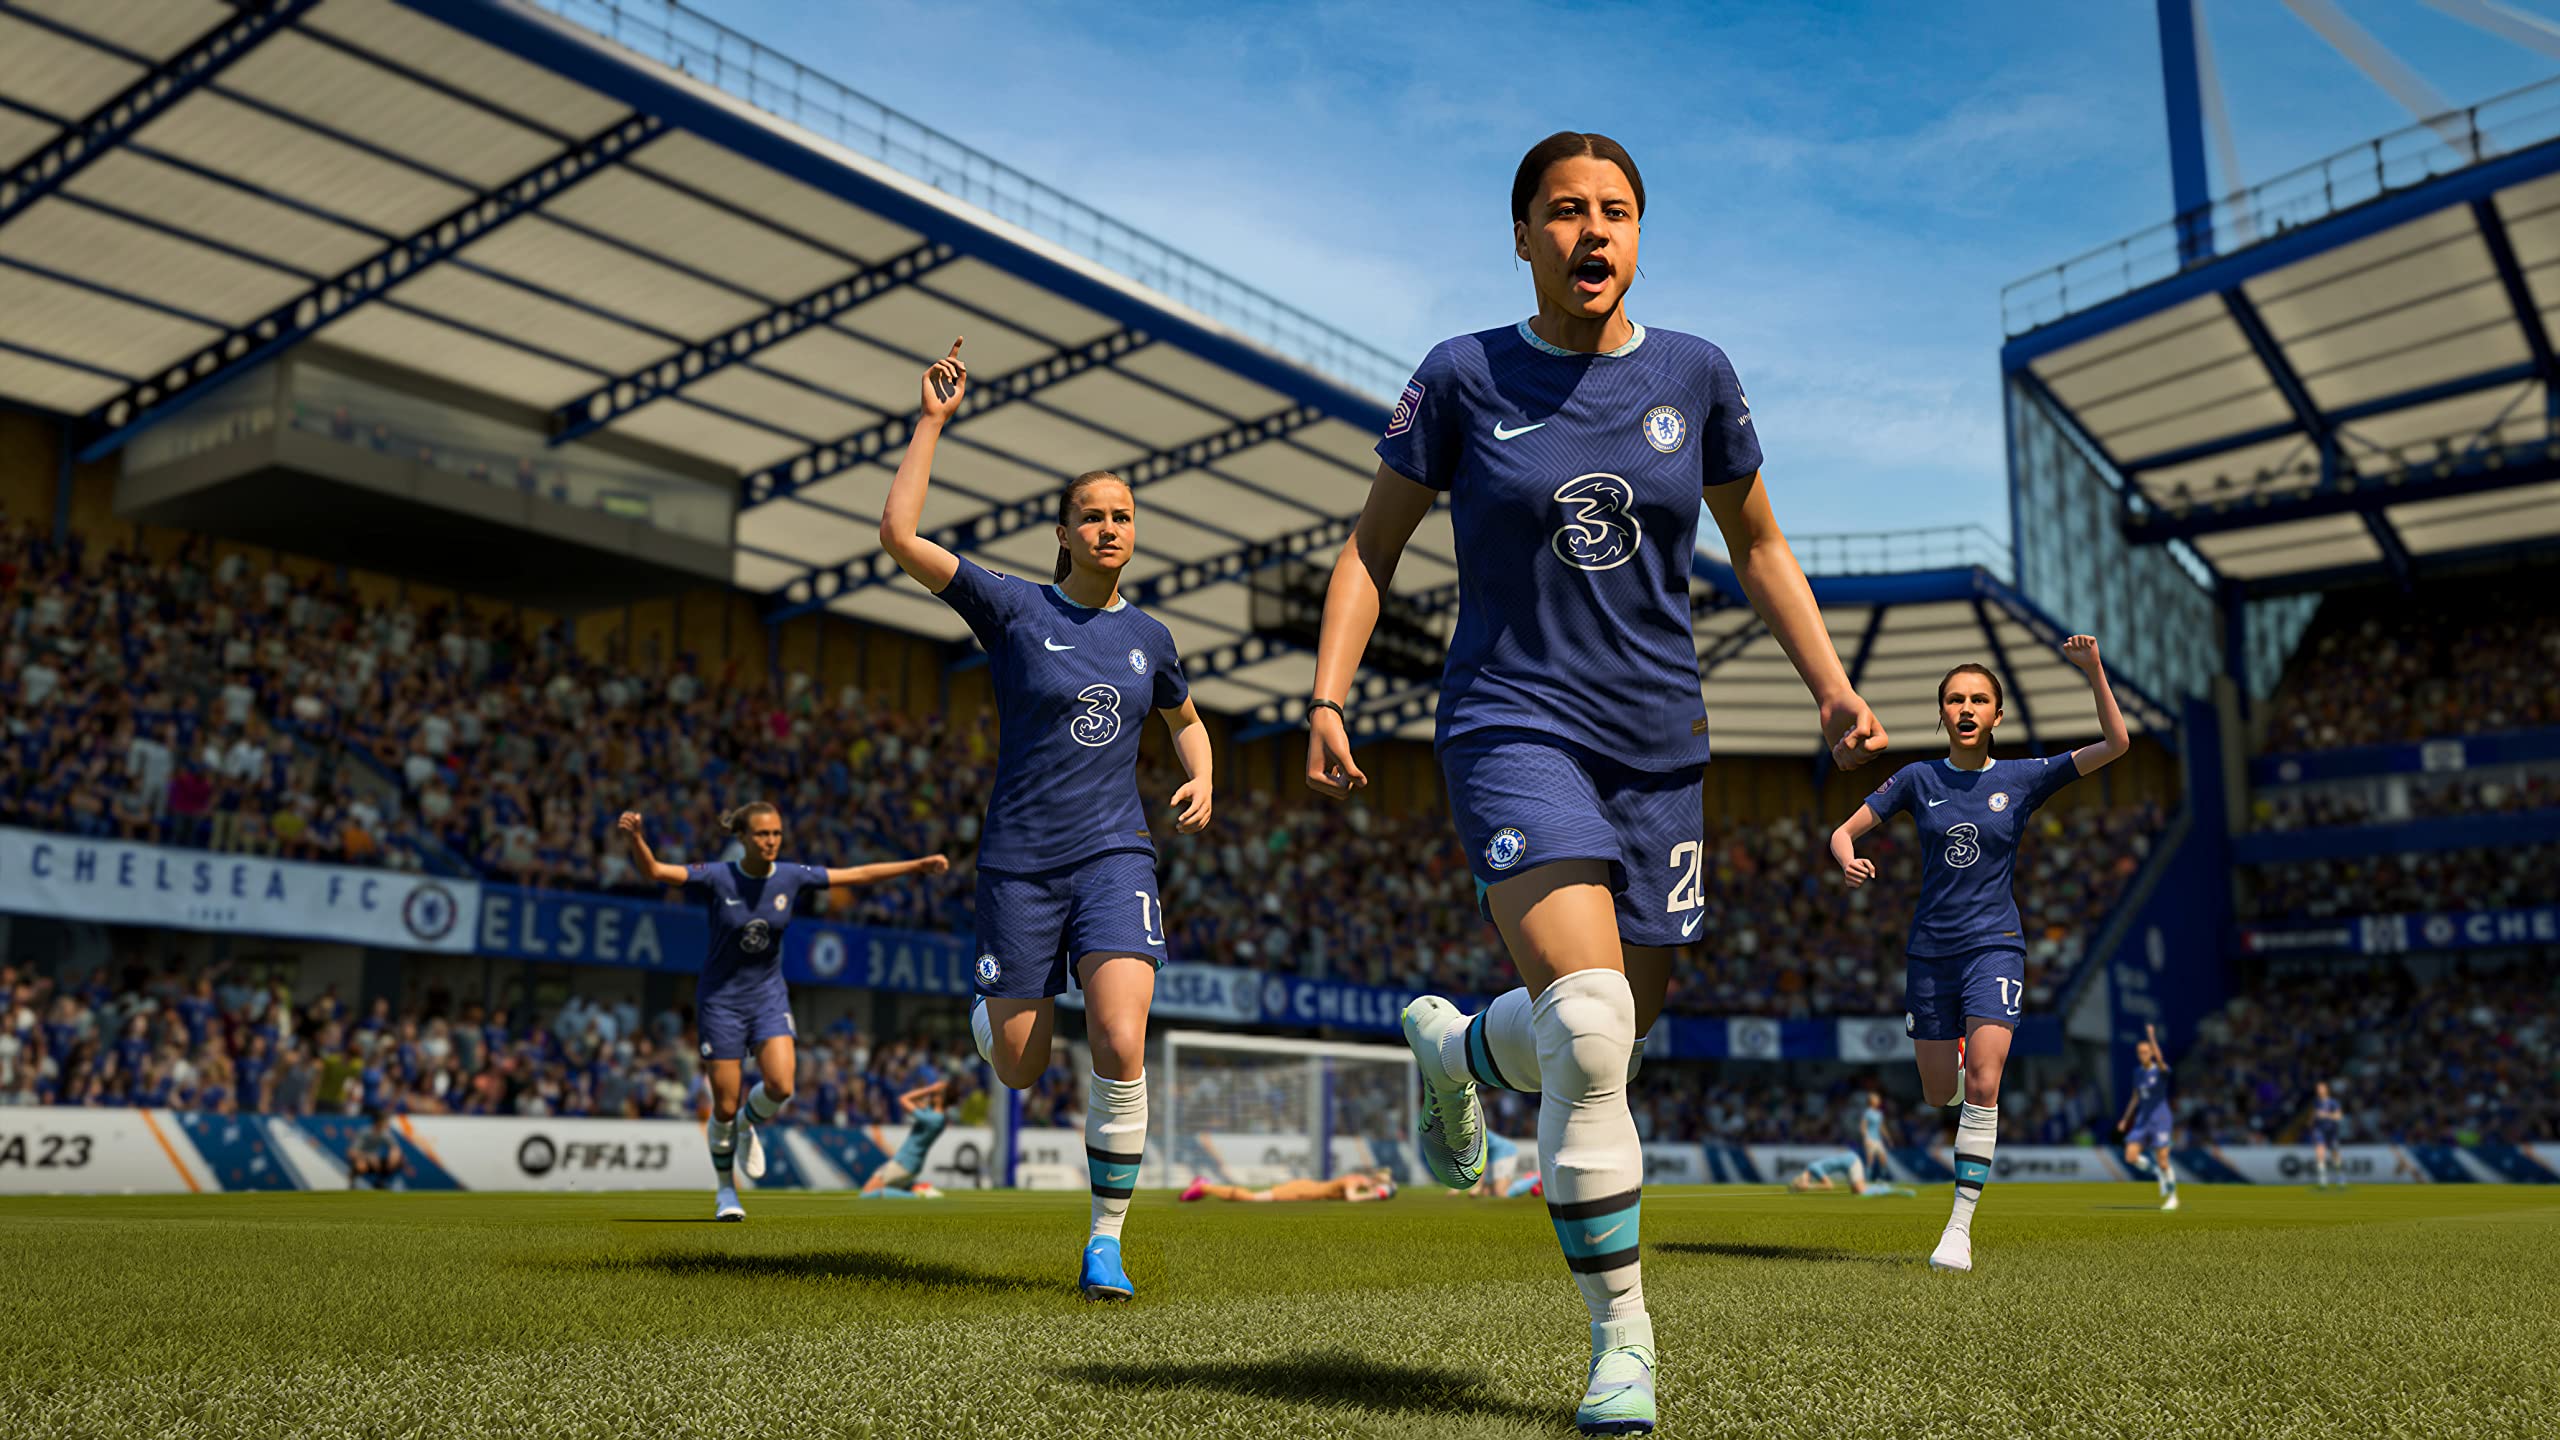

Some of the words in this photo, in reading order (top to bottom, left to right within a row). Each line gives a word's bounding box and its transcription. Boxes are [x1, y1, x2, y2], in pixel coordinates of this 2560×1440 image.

[1649, 408, 1677, 418] CHELSEA
[1552, 473, 1641, 571] 3
[1070, 683, 1121, 747] 3
[31, 843, 286, 900] CHELSEA
[327, 874, 378, 911] FC
[37, 1133, 93, 1169] 23
[562, 1142, 628, 1170] FIFA
[634, 1142, 670, 1170] 23
